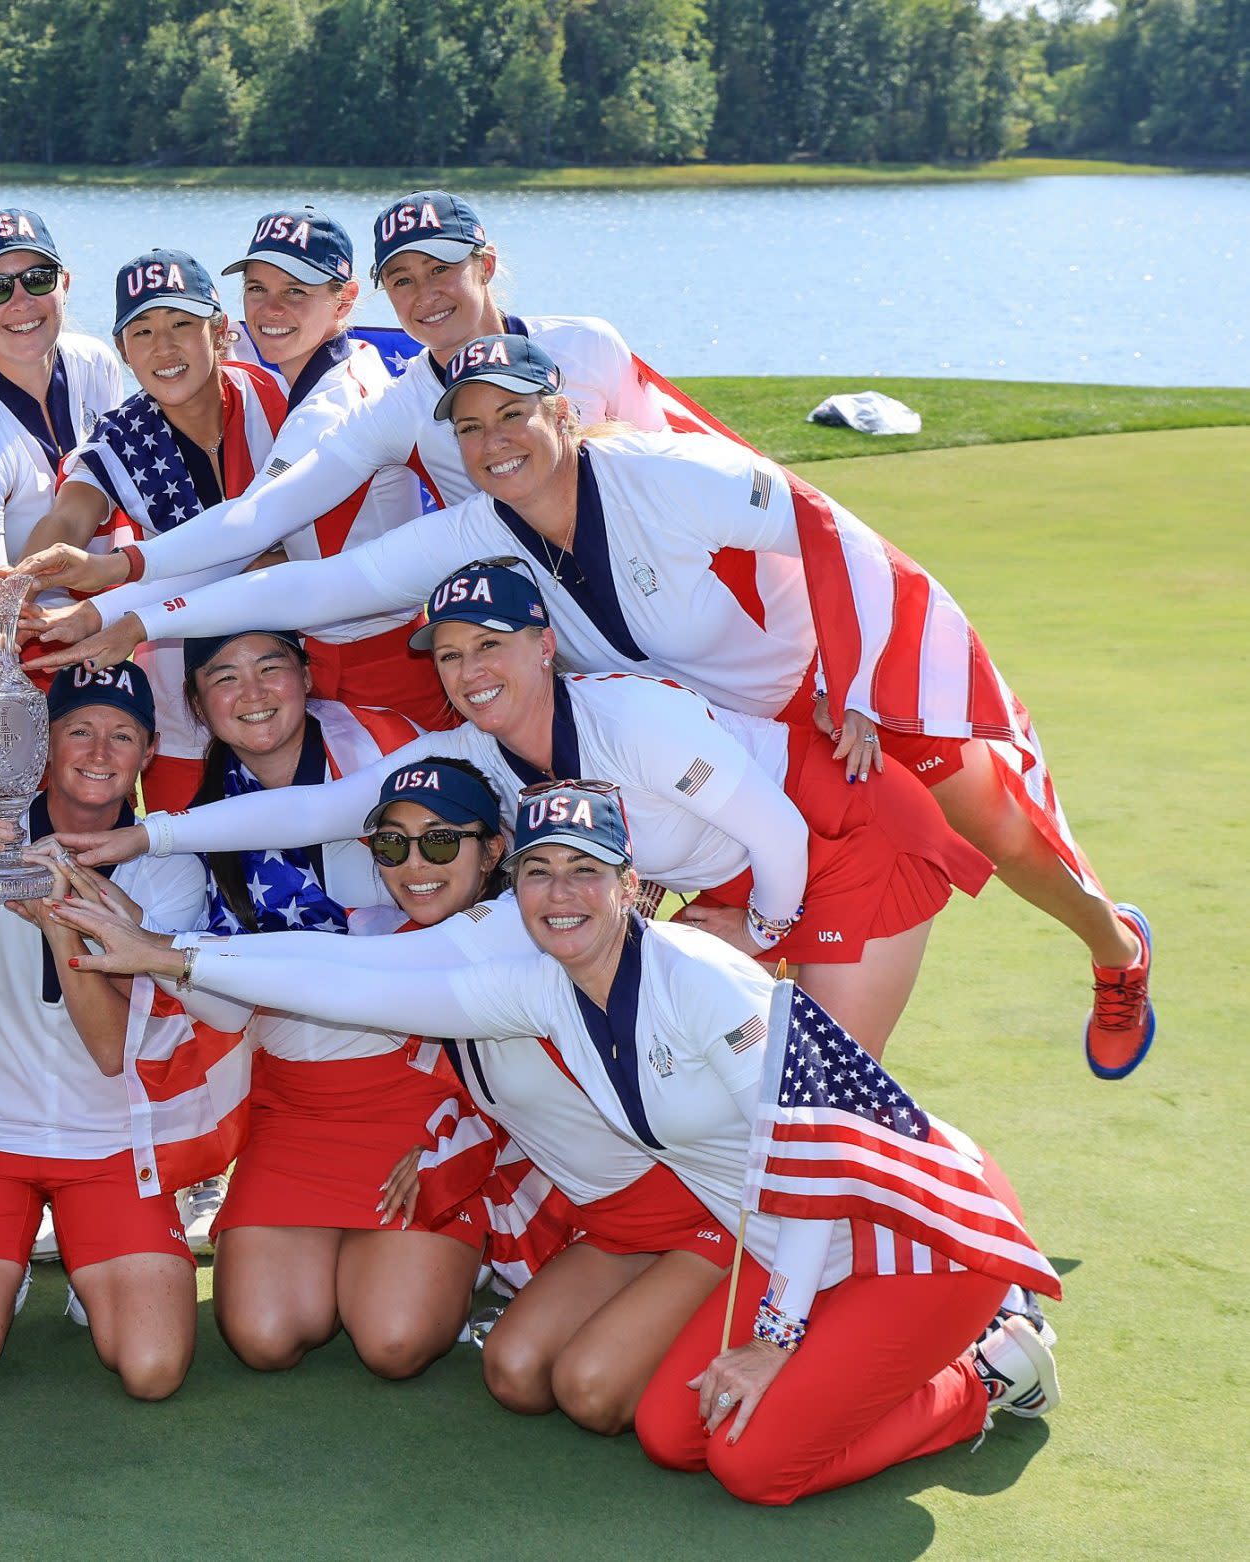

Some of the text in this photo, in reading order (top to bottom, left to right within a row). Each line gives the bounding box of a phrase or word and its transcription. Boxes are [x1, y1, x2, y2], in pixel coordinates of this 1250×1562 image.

[254, 215, 311, 250] USA
[380, 203, 441, 241] USA
[127, 264, 186, 298] USA
[451, 341, 510, 379] USA
[434, 577, 493, 612] USA
[73, 664, 134, 697] USA
[917, 756, 944, 772] USA
[395, 770, 440, 792] USA
[529, 796, 594, 831] USA
[818, 930, 843, 943] USA
[459, 1211, 472, 1224] SA
[697, 1230, 721, 1244] USA
